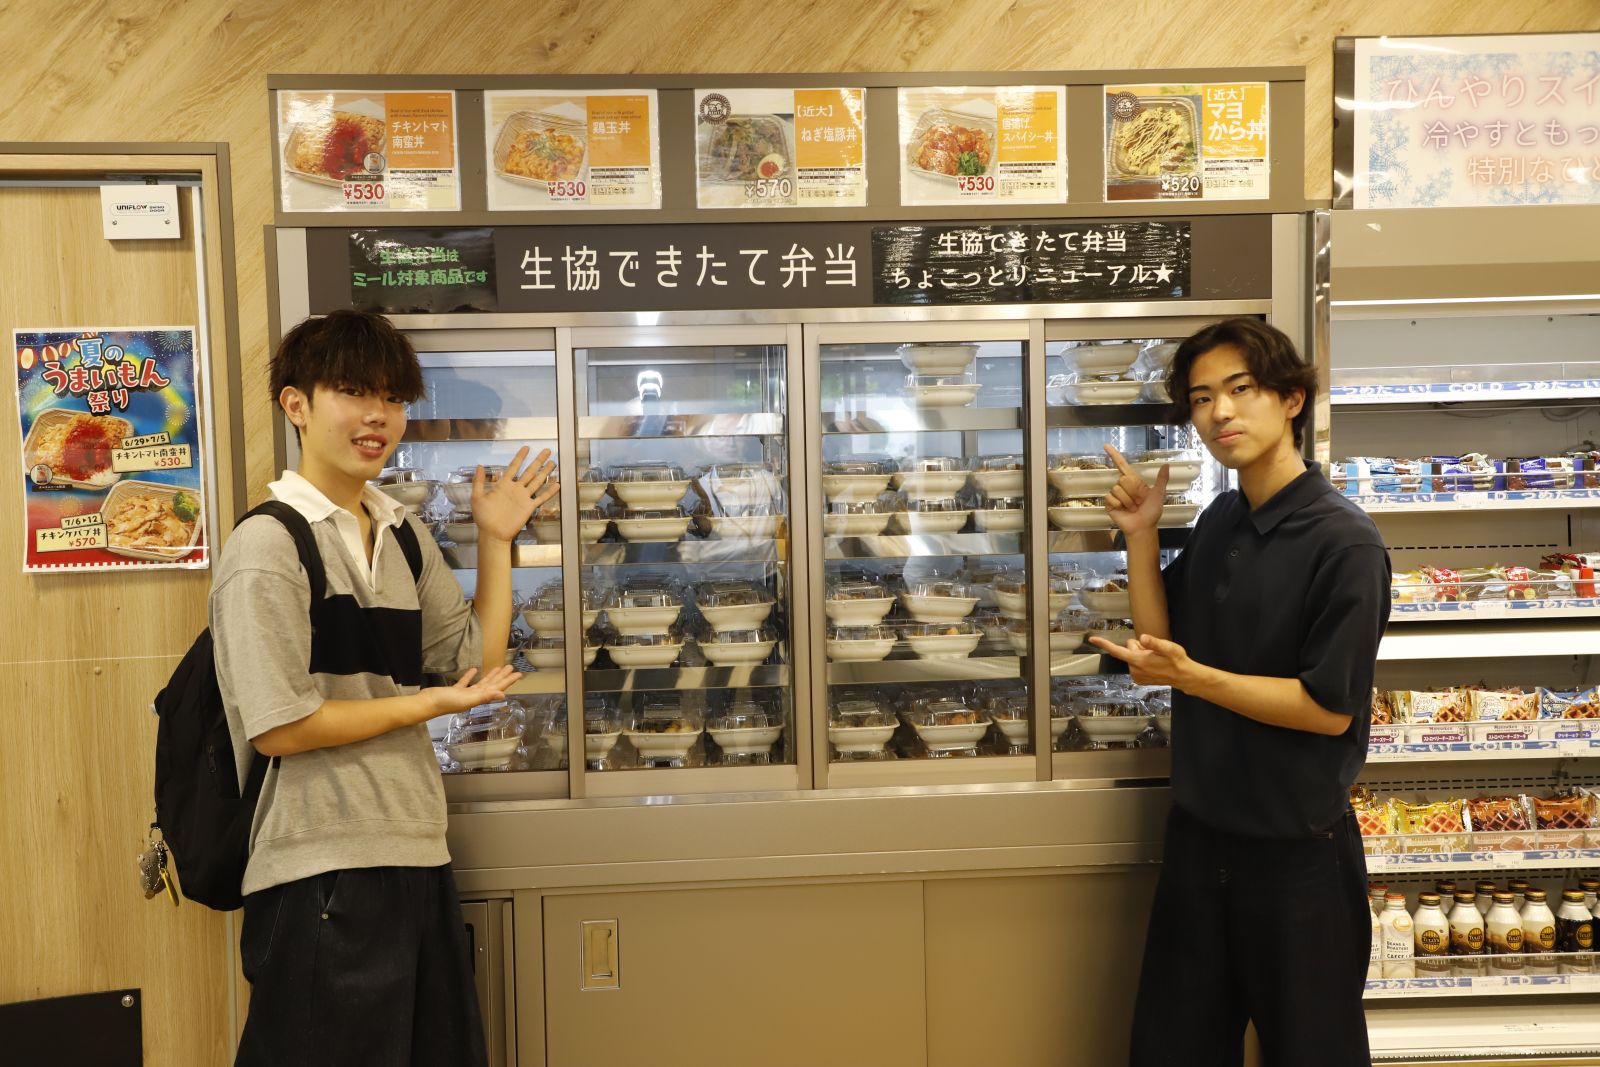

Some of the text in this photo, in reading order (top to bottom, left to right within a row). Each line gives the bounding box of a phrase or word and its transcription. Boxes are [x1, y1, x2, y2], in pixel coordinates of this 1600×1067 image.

[1208, 102, 1243, 119] マヨ
[391, 120, 448, 133] チキントマト
[801, 127, 857, 142] ねぎ塩豚丼
[1208, 119, 1265, 141] から丼
[391, 135, 424, 149] 南蛮丼
[1422, 120, 1600, 150] 冷やすともっ
[549, 181, 586, 197] ¥530
[745, 178, 793, 198] ¥570
[959, 176, 995, 191] ¥530
[1161, 176, 1200, 192] ¥520
[344, 184, 385, 200] ¥530
[937, 230, 1127, 255] 生協できたて弁当
[520, 243, 857, 291] 生協できたて弁当
[354, 268, 489, 287] ミール対象商品です
[77, 338, 123, 368] 夏の
[43, 358, 170, 394] うまいもん
[1449, 381, 1504, 392] COLD
[88, 388, 129, 413] 祭り
[116, 447, 187, 460] チキントマト南蛮丼
[154, 456, 181, 467] ¥530
[41, 528, 101, 540] チキンケバブ丼
[69, 536, 97, 547] ¥570
